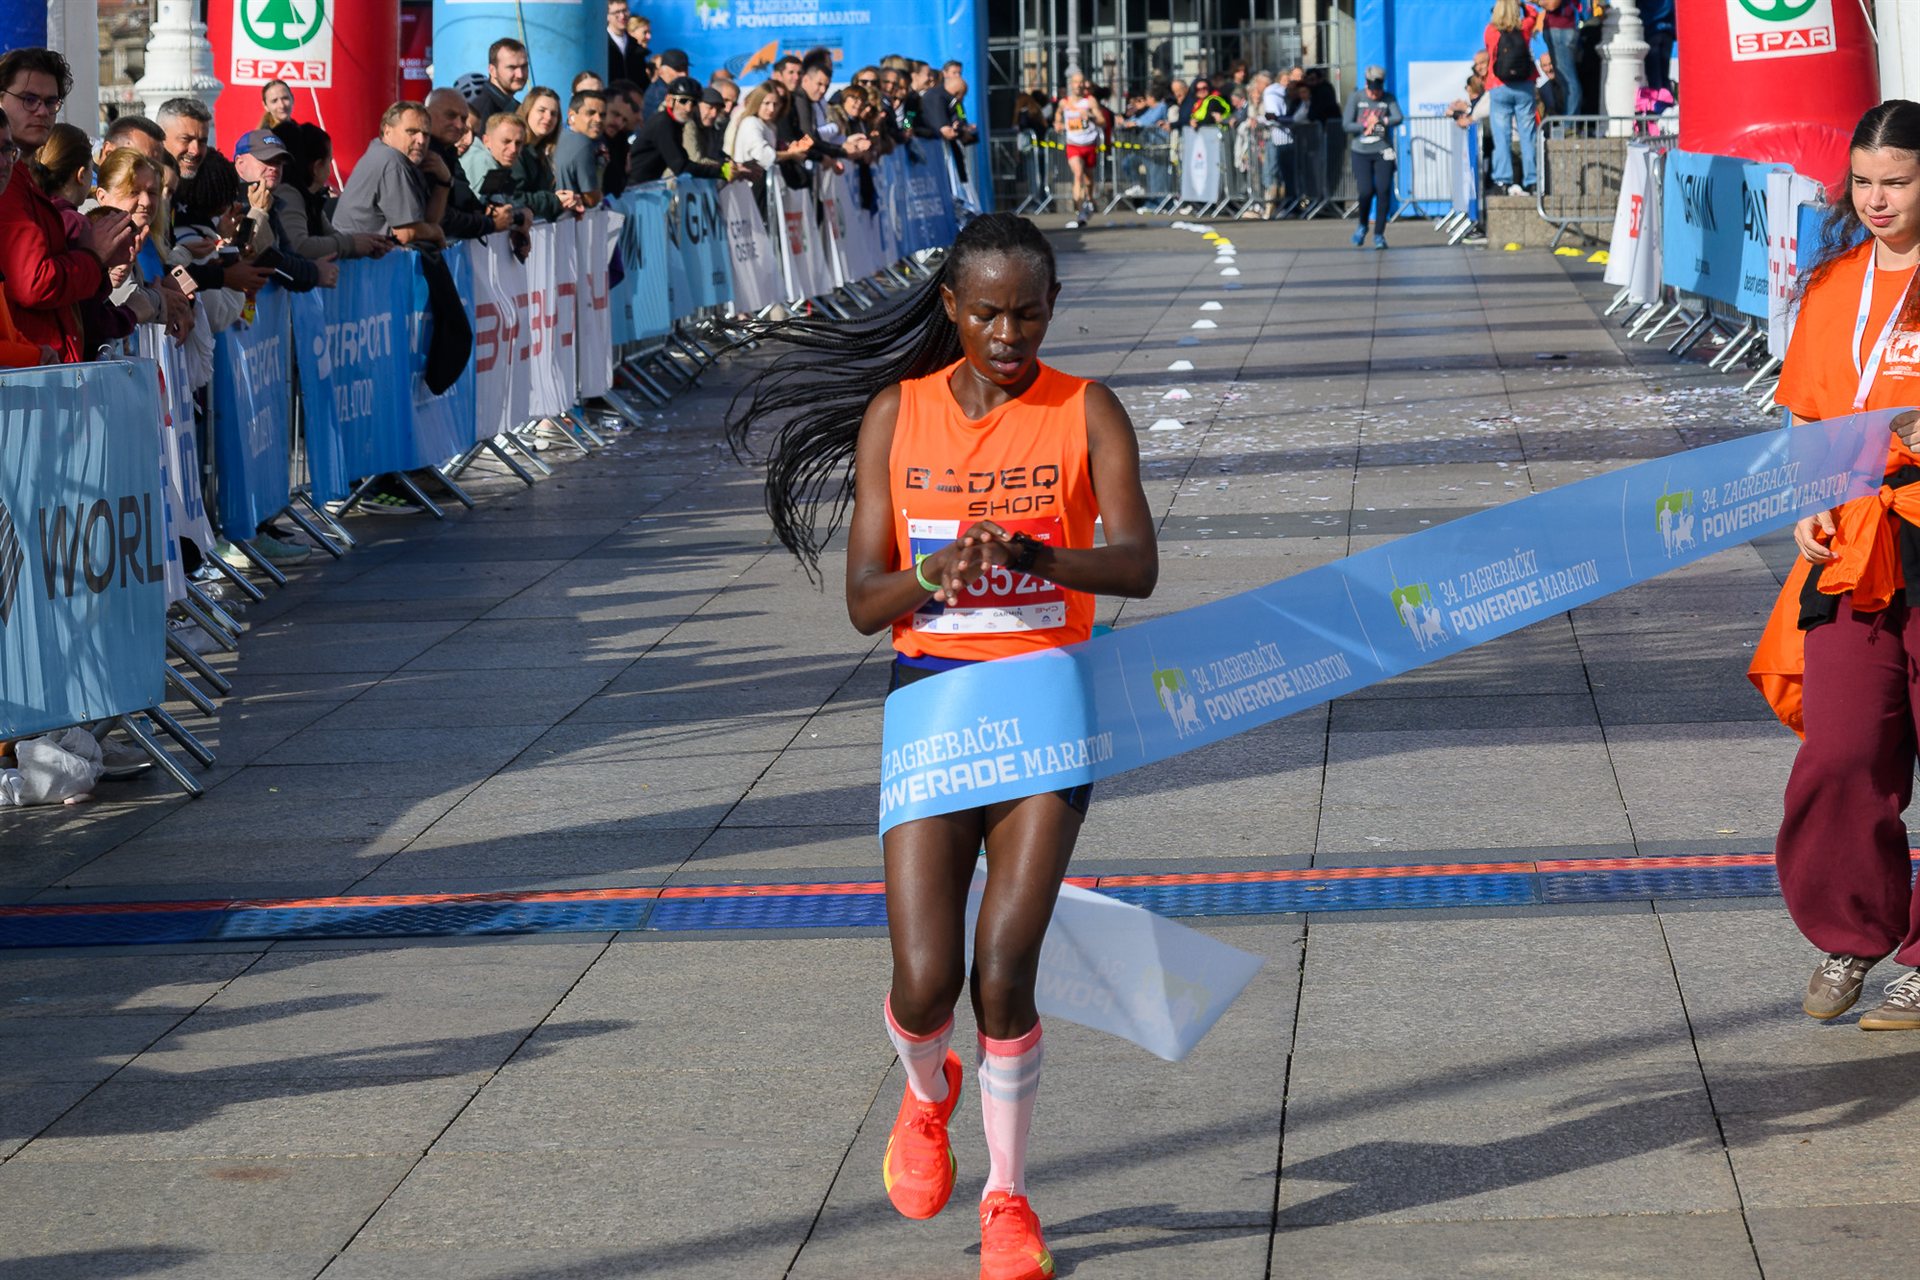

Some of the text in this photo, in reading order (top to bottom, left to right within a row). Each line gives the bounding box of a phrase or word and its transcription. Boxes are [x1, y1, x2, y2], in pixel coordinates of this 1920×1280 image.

[1738, 28, 1829, 53] SPAR
[237, 60, 325, 80] SPAR
[968, 495, 1055, 517] SHOP
[1702, 456, 1800, 513] 34. ZAGREBAČKI
[1702, 471, 1851, 542] POWERADE MARATON
[39, 493, 164, 600] WORL
[1438, 548, 1538, 606] 34. ZAGREBAČKI
[1450, 559, 1599, 635] POWERADE MARATON
[1192, 640, 1286, 694] 34. ZAGREBAČKI
[1204, 652, 1351, 725] POWERADE MARATON
[883, 716, 1023, 782] ZAGREBAČKI
[1021, 731, 1113, 778] MARATON
